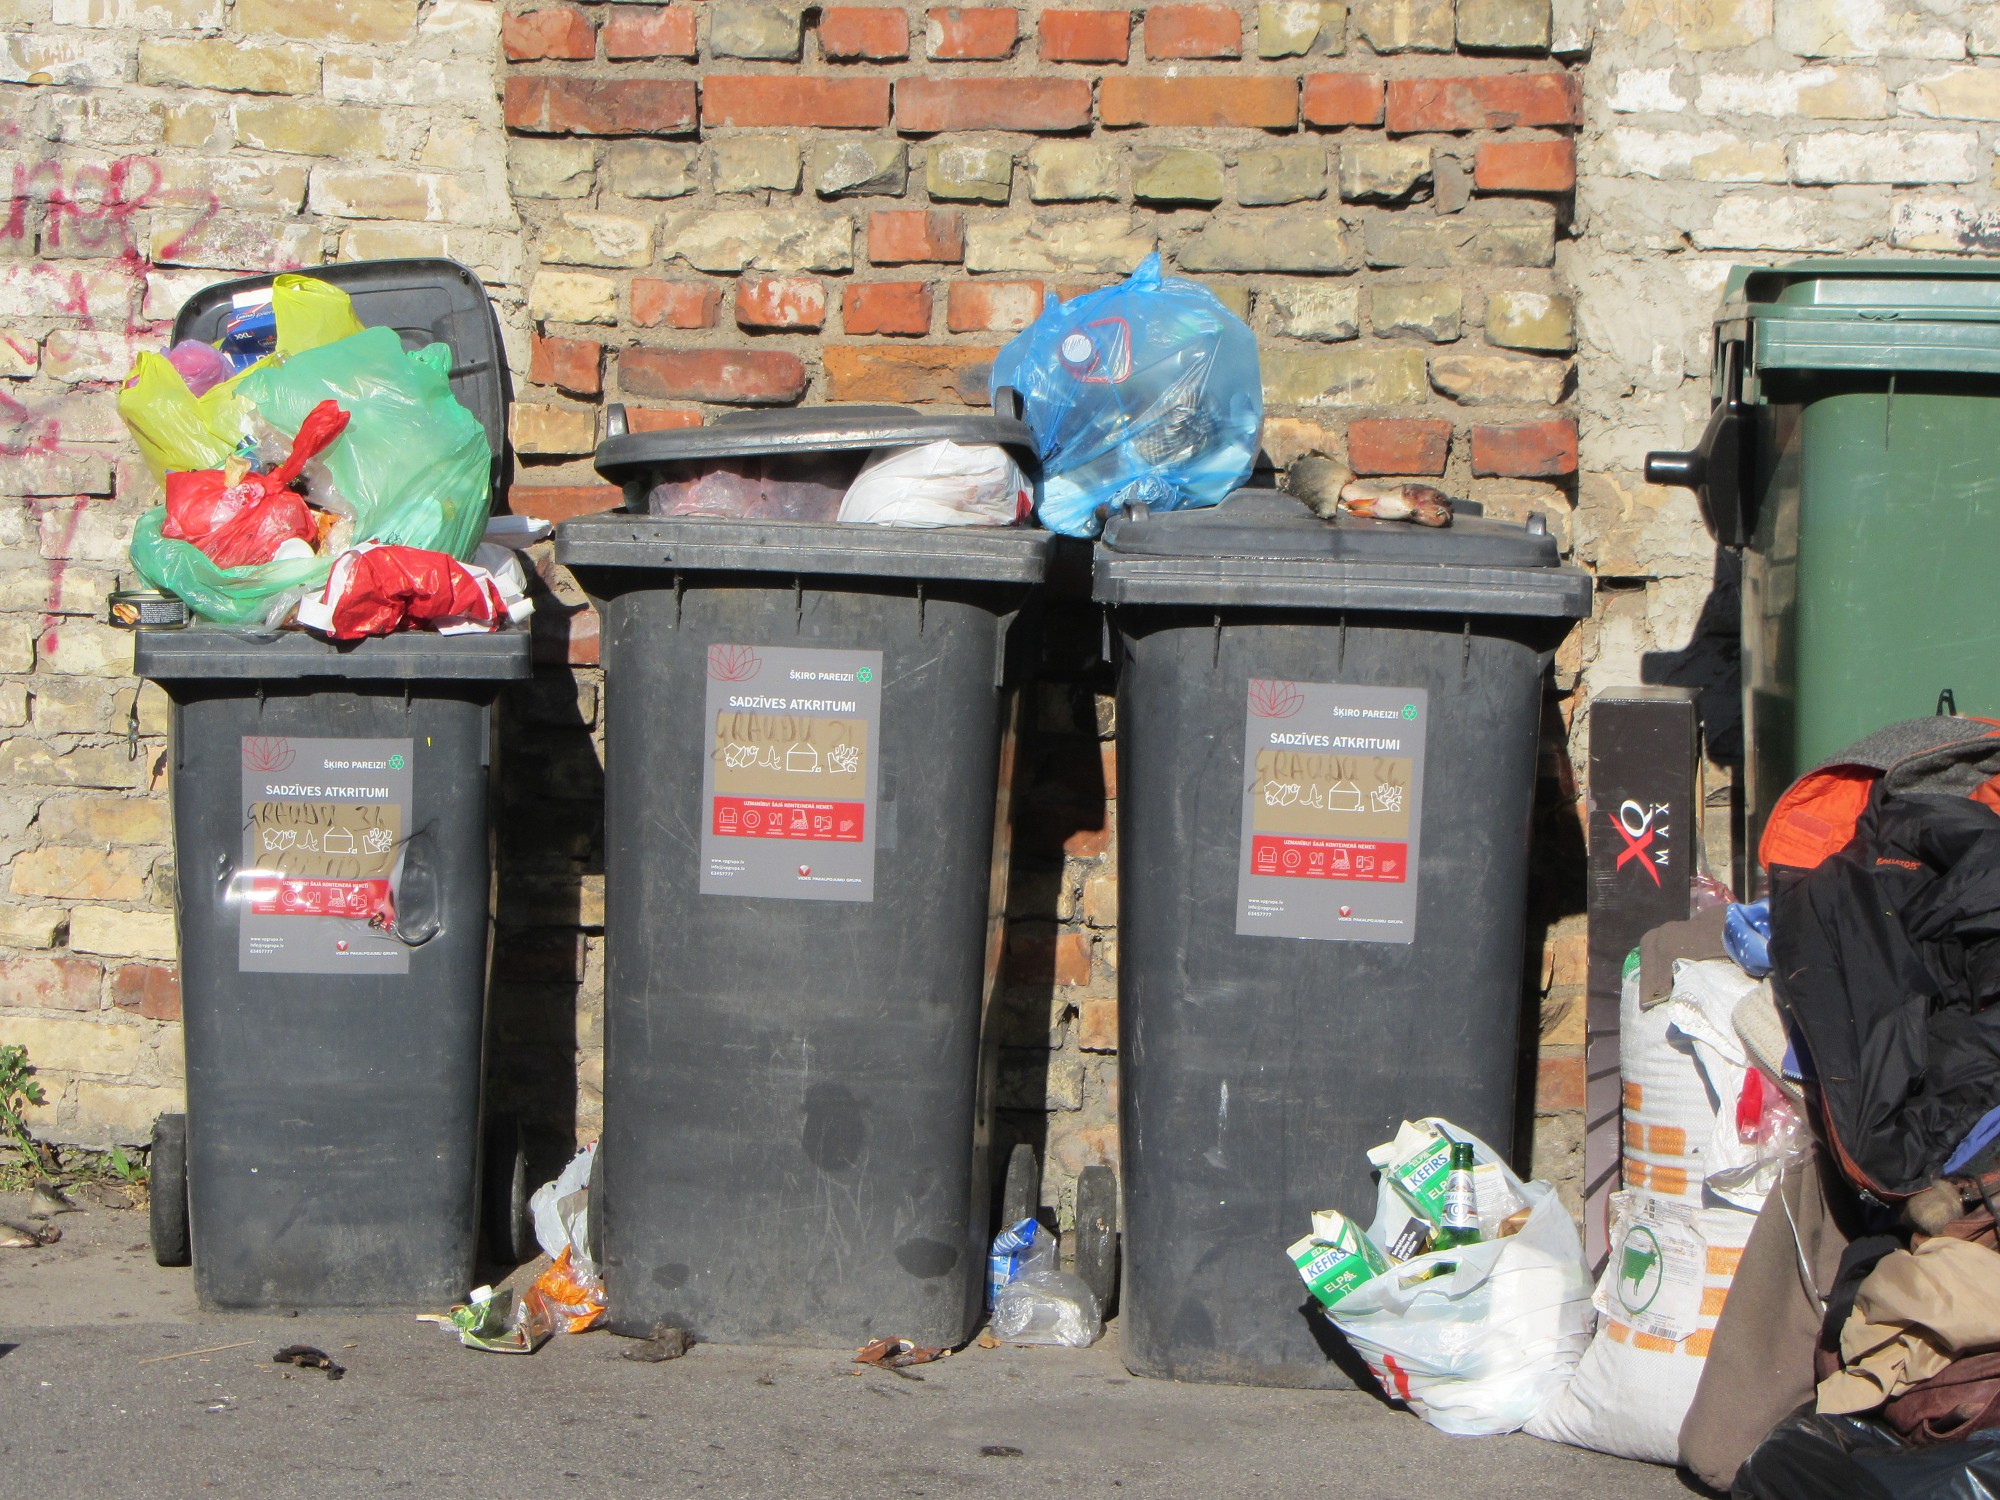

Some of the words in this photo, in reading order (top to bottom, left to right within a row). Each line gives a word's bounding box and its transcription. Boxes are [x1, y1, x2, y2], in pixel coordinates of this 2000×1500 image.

[234, 331, 253, 341] XXL
[789, 669, 816, 681] ŠĶIRO
[818, 672, 854, 682] PAREIZI!
[729, 695, 786, 709] SADZĪVES
[789, 699, 856, 712] ATKRITUMI
[1333, 706, 1360, 718] ŠĶIRO
[1362, 709, 1399, 719] PAREIZI!
[1270, 732, 1329, 747] SADZĪVES
[1333, 736, 1400, 750] ATKRITUMI
[323, 759, 349, 770] ŠĶIRO
[352, 761, 386, 769] PAREIZI!
[266, 784, 321, 796] SADZĪVES
[325, 787, 389, 798] ATKRITUMI
[1654, 802, 1669, 866] MAX
